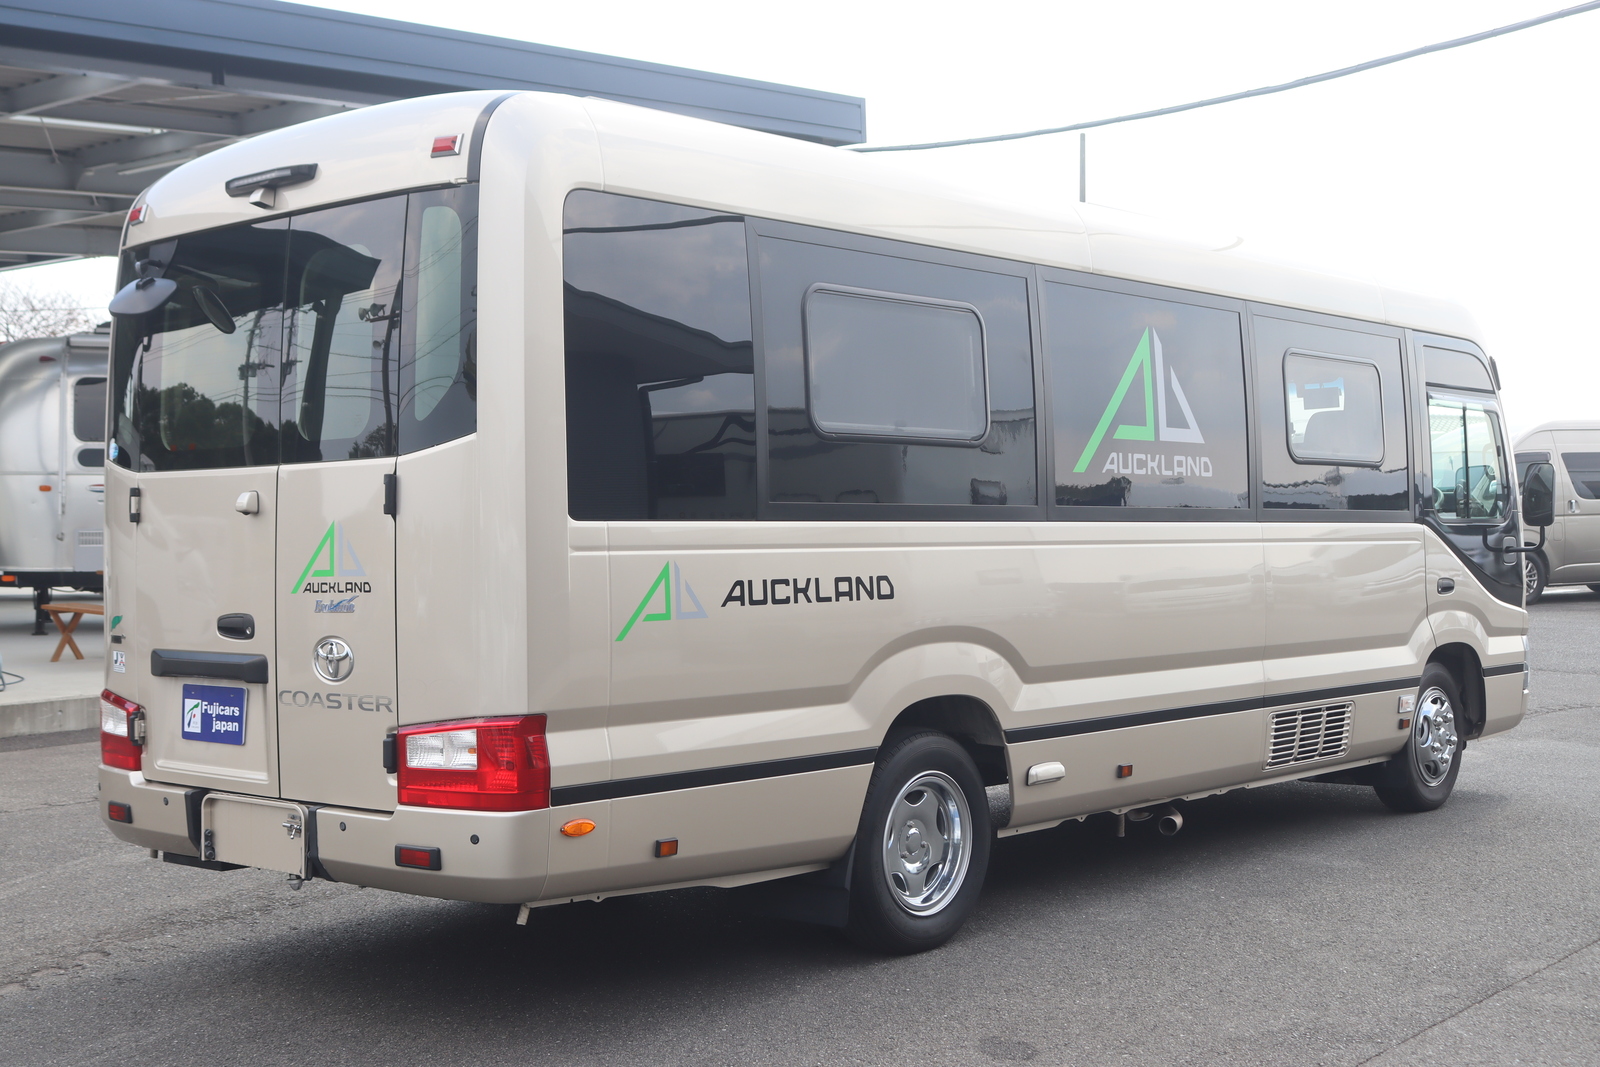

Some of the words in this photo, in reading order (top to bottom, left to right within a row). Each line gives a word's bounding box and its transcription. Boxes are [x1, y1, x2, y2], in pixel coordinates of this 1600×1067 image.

[1102, 452, 1213, 477] AUCKLAND
[303, 581, 372, 594] AUCKLAND
[721, 575, 895, 607] AUCKLAND
[202, 701, 240, 717] Fujicars
[279, 690, 393, 713] COASTER
[211, 717, 239, 733] japan
